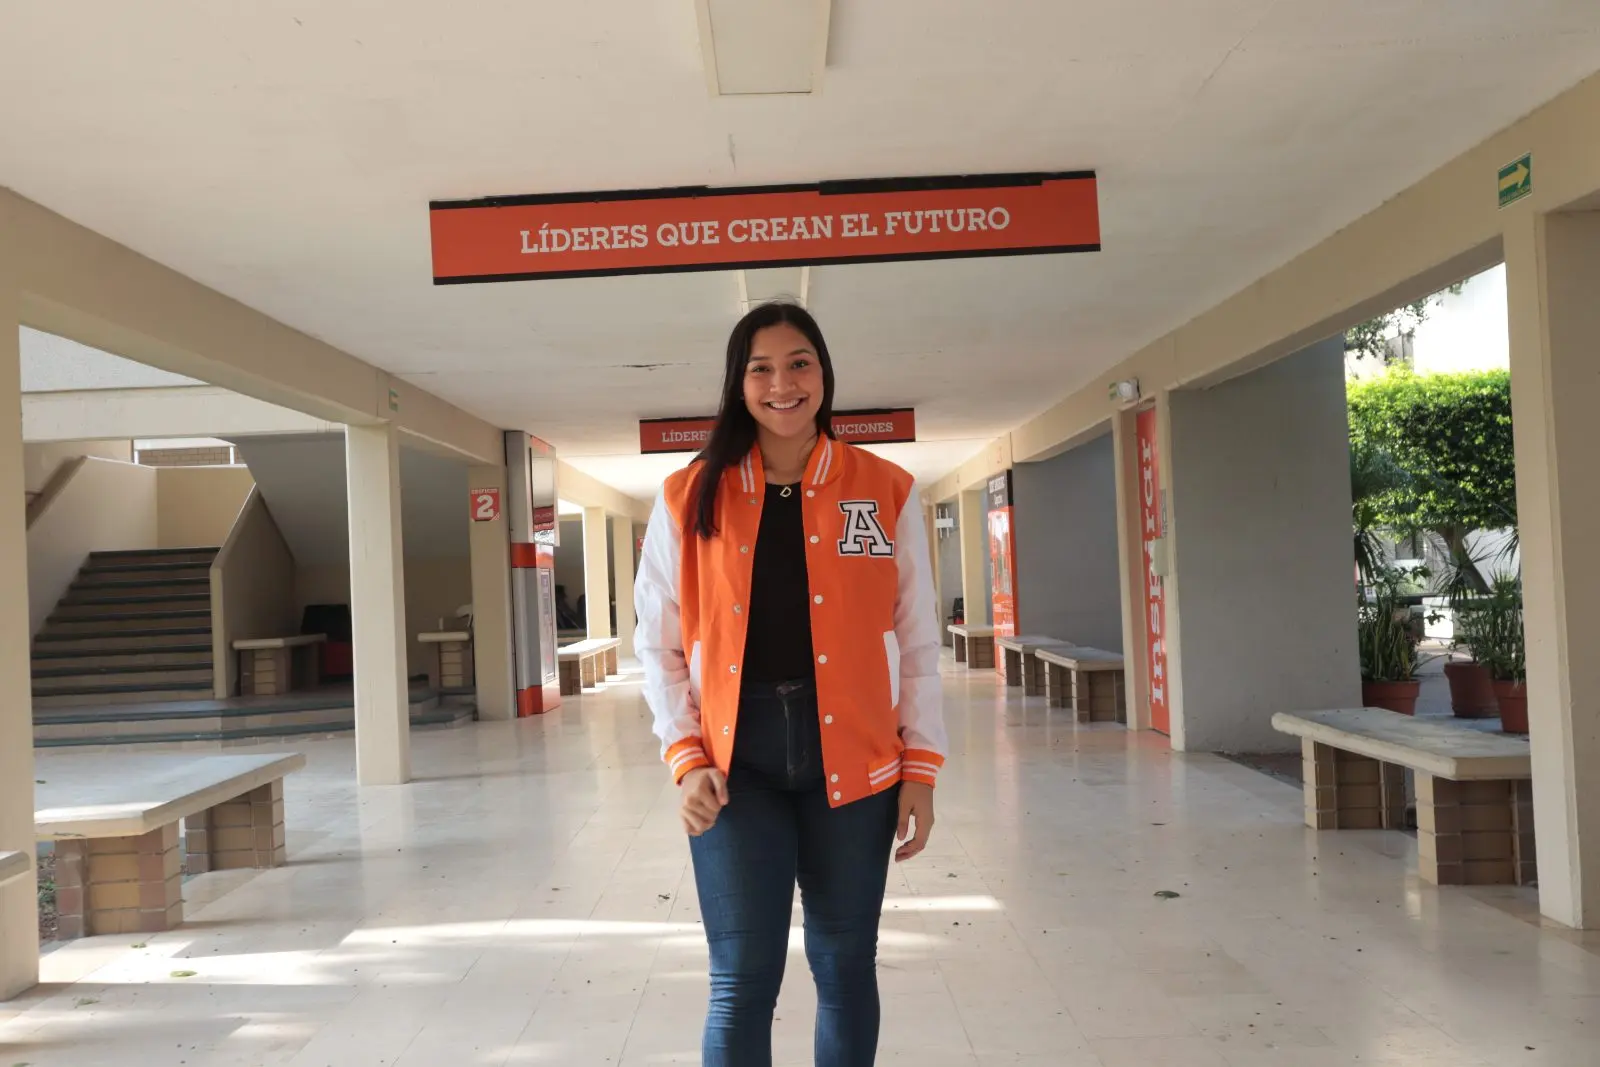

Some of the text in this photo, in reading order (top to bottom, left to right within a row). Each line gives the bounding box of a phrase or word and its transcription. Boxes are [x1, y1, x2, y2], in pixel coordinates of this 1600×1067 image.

[520, 206, 1010, 253] LÍDERES QUE CREAN EL FUTURO
[477, 495, 493, 518] 2
[838, 500, 894, 558] A
